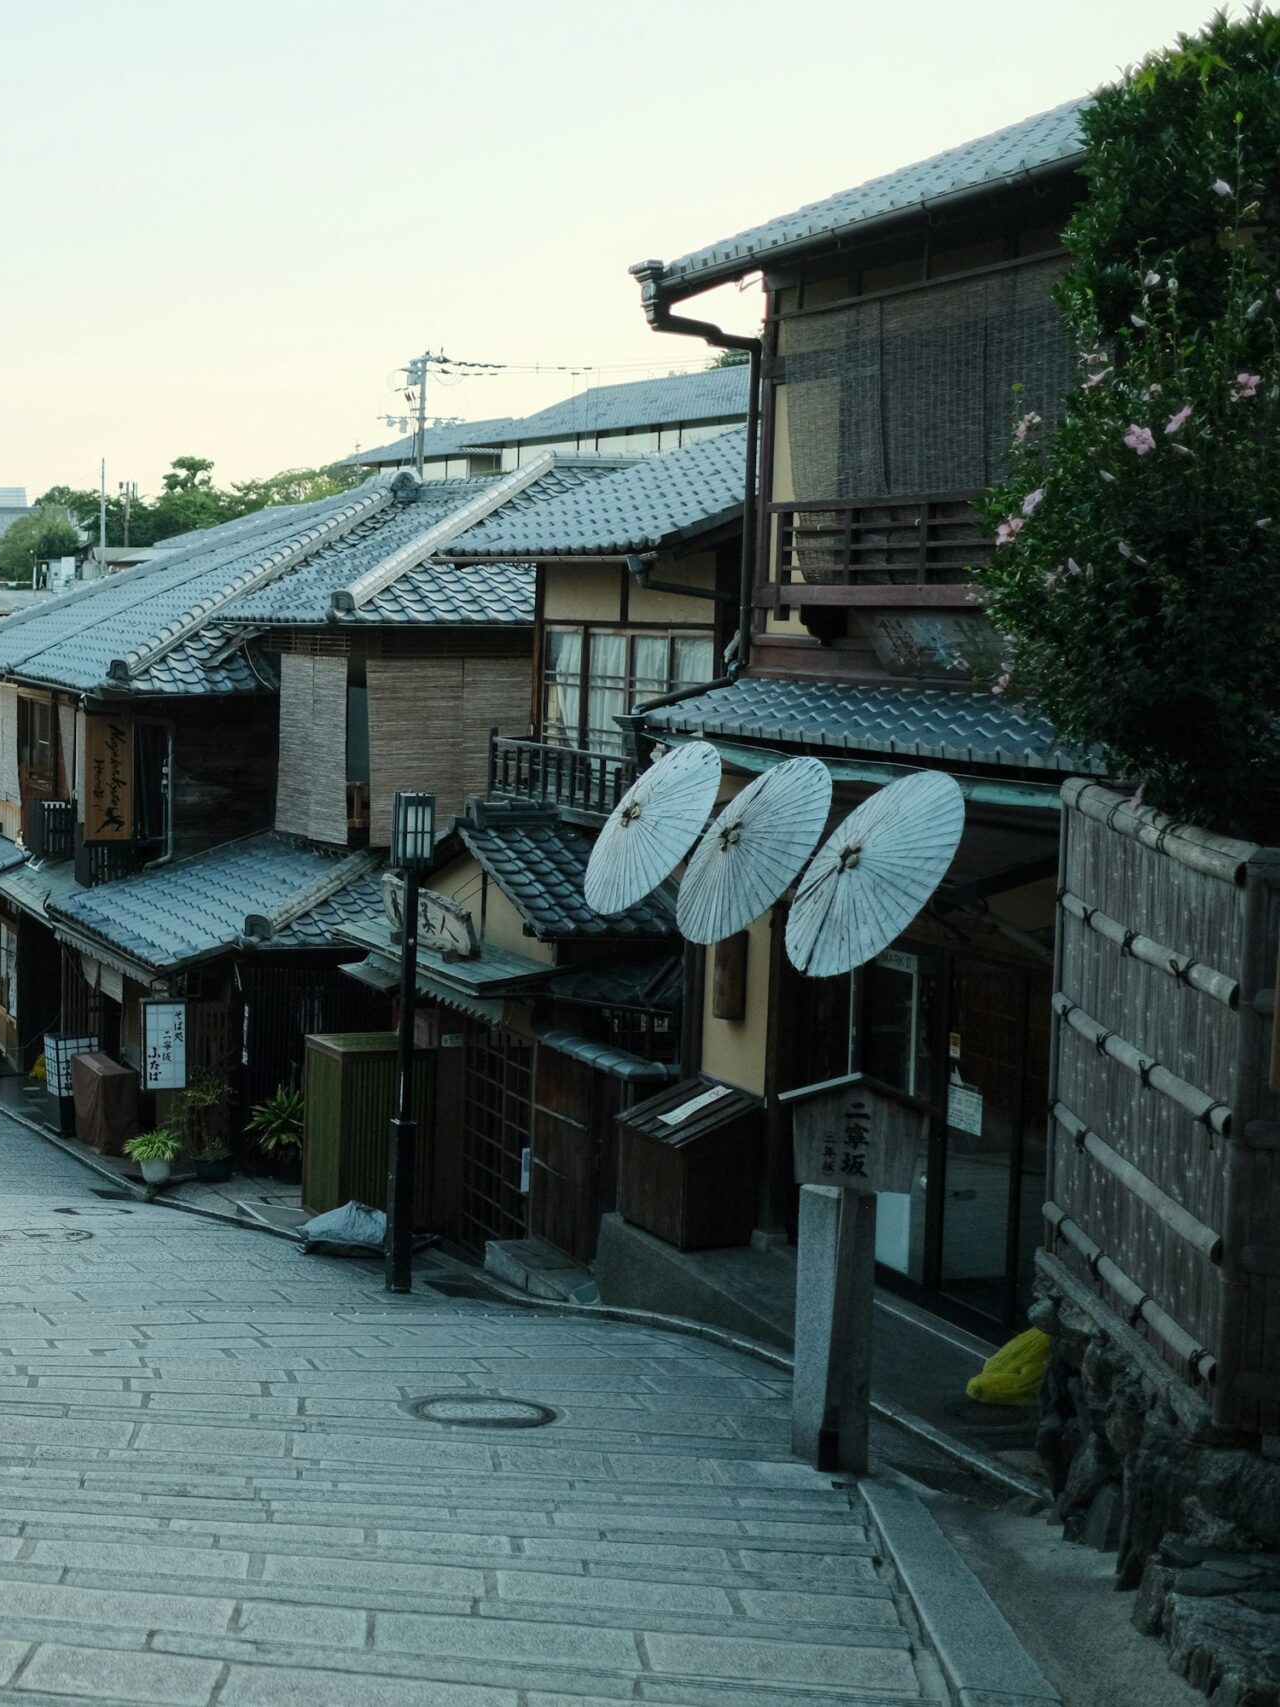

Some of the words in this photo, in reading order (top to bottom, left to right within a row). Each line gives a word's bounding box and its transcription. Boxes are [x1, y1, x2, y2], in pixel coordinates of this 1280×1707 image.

[174, 1010, 184, 1042] そば処
[162, 1031, 173, 1062] 二寧坂
[148, 1047, 162, 1081] ふたば
[840, 1102, 871, 1178] 二寧坂
